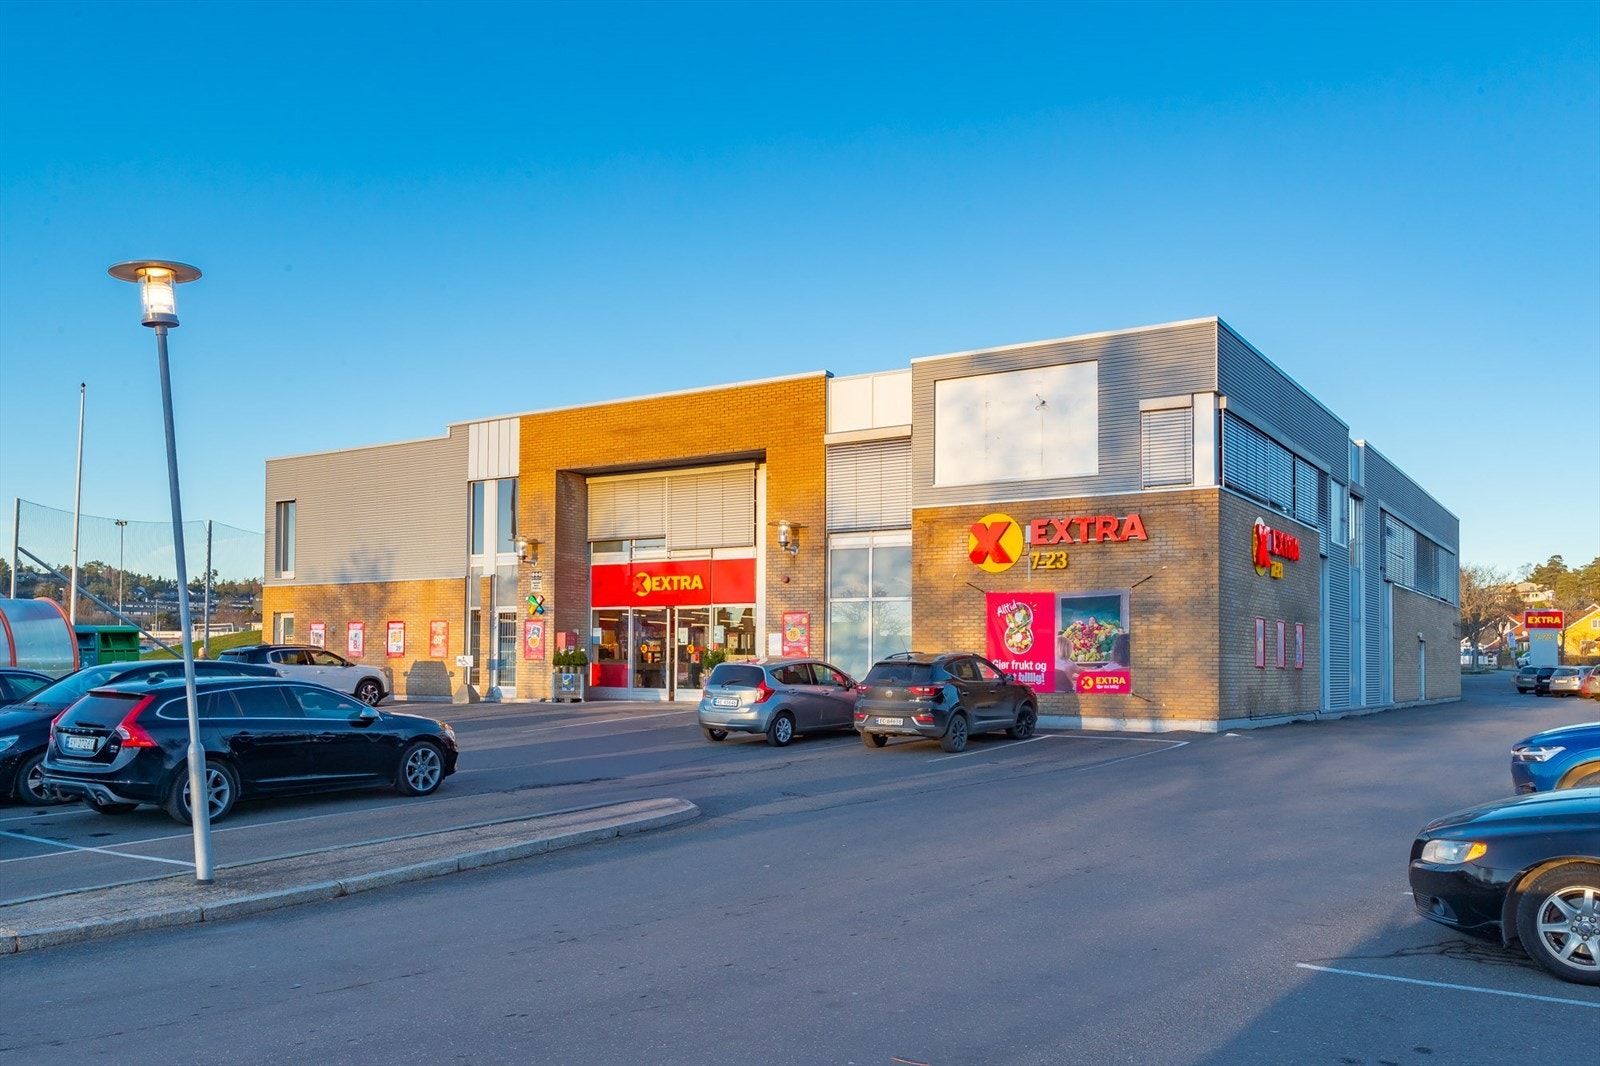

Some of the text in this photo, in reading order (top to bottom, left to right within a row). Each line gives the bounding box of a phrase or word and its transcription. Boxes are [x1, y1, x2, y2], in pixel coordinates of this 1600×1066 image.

[1031, 514, 1148, 546] EXTRA
[1031, 551, 1068, 570] 7-23
[652, 574, 704, 591] EXTRA
[1527, 616, 1561, 624] EXTRA
[1011, 660, 1034, 670] frukt
[1035, 662, 1047, 672] og
[1018, 672, 1046, 685] billig!
[1096, 676, 1126, 684] EXTRA
